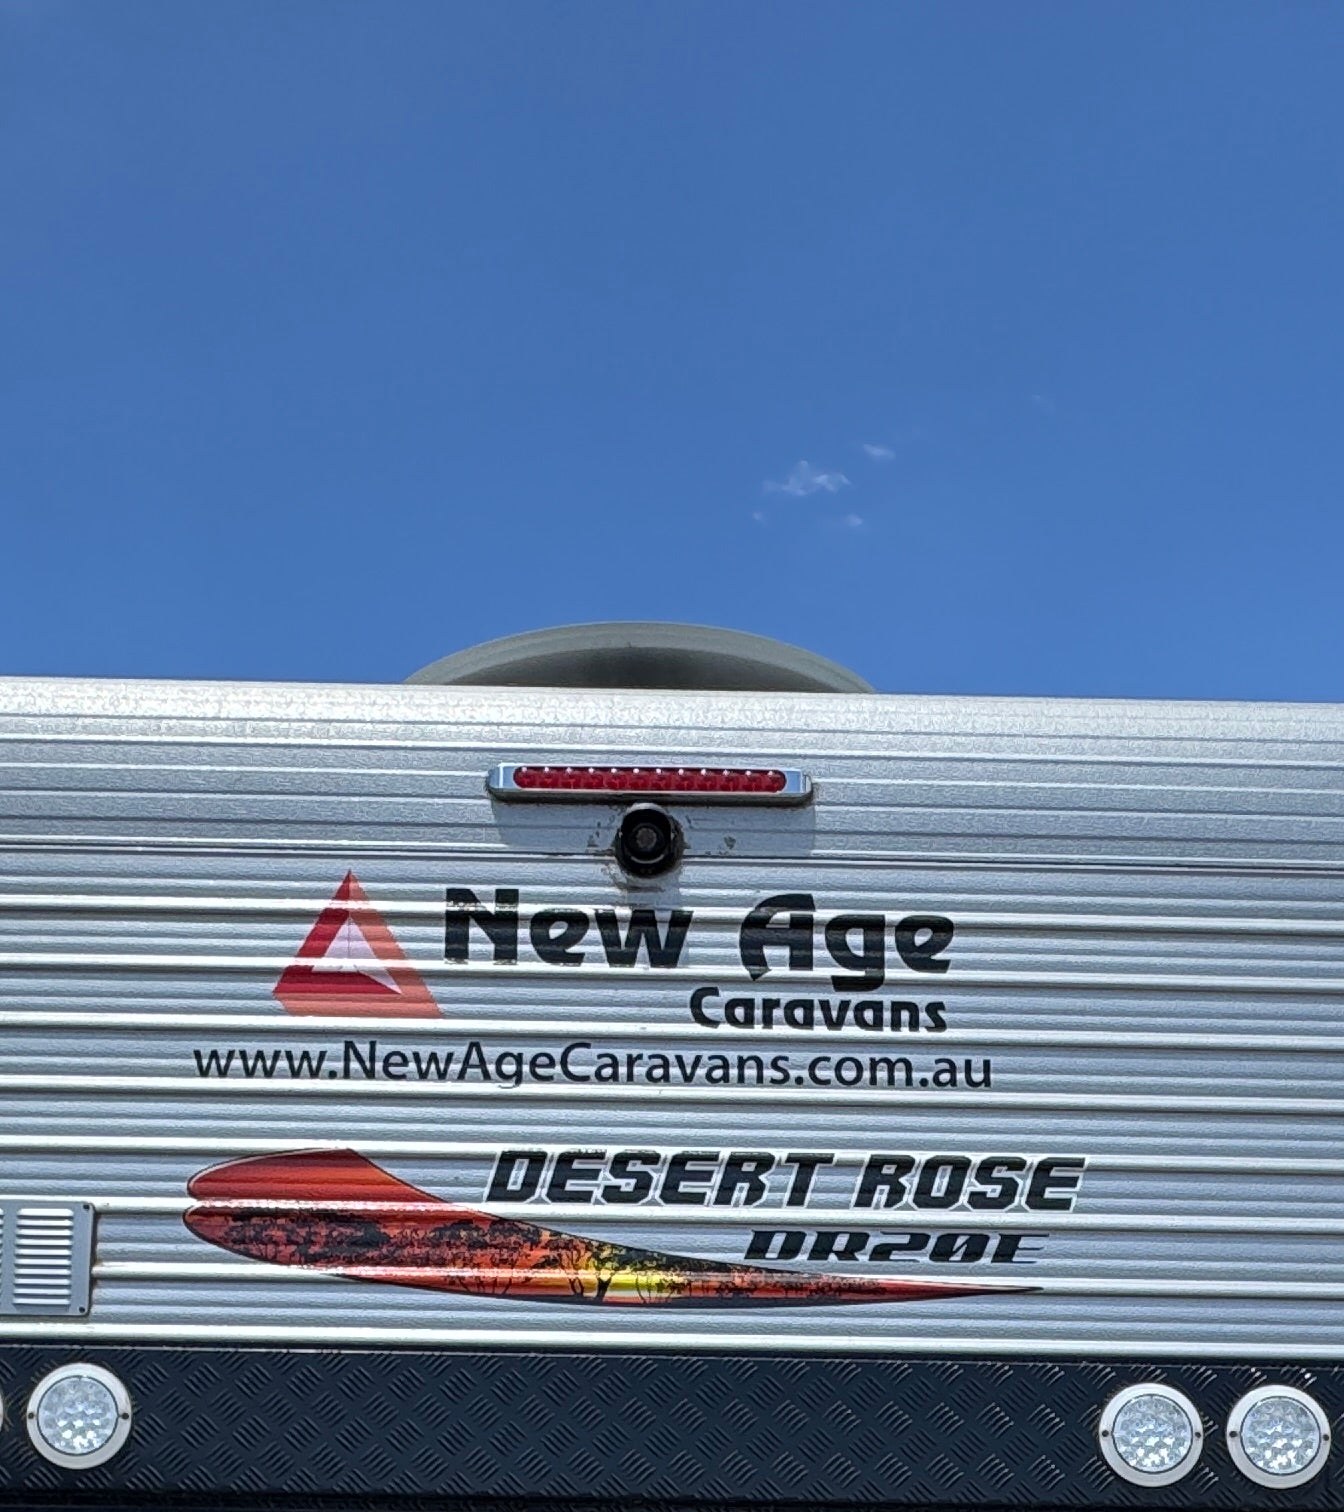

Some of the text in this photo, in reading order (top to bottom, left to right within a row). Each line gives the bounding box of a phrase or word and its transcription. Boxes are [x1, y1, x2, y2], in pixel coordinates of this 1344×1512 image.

[444, 887, 955, 992] New Age
[689, 985, 949, 1034] Caravans
[193, 1040, 994, 1090] www.NewAgeCaravans.com.au
[485, 1148, 1087, 1212] DESERT ROSE
[743, 1230, 1050, 1266] DR20E
